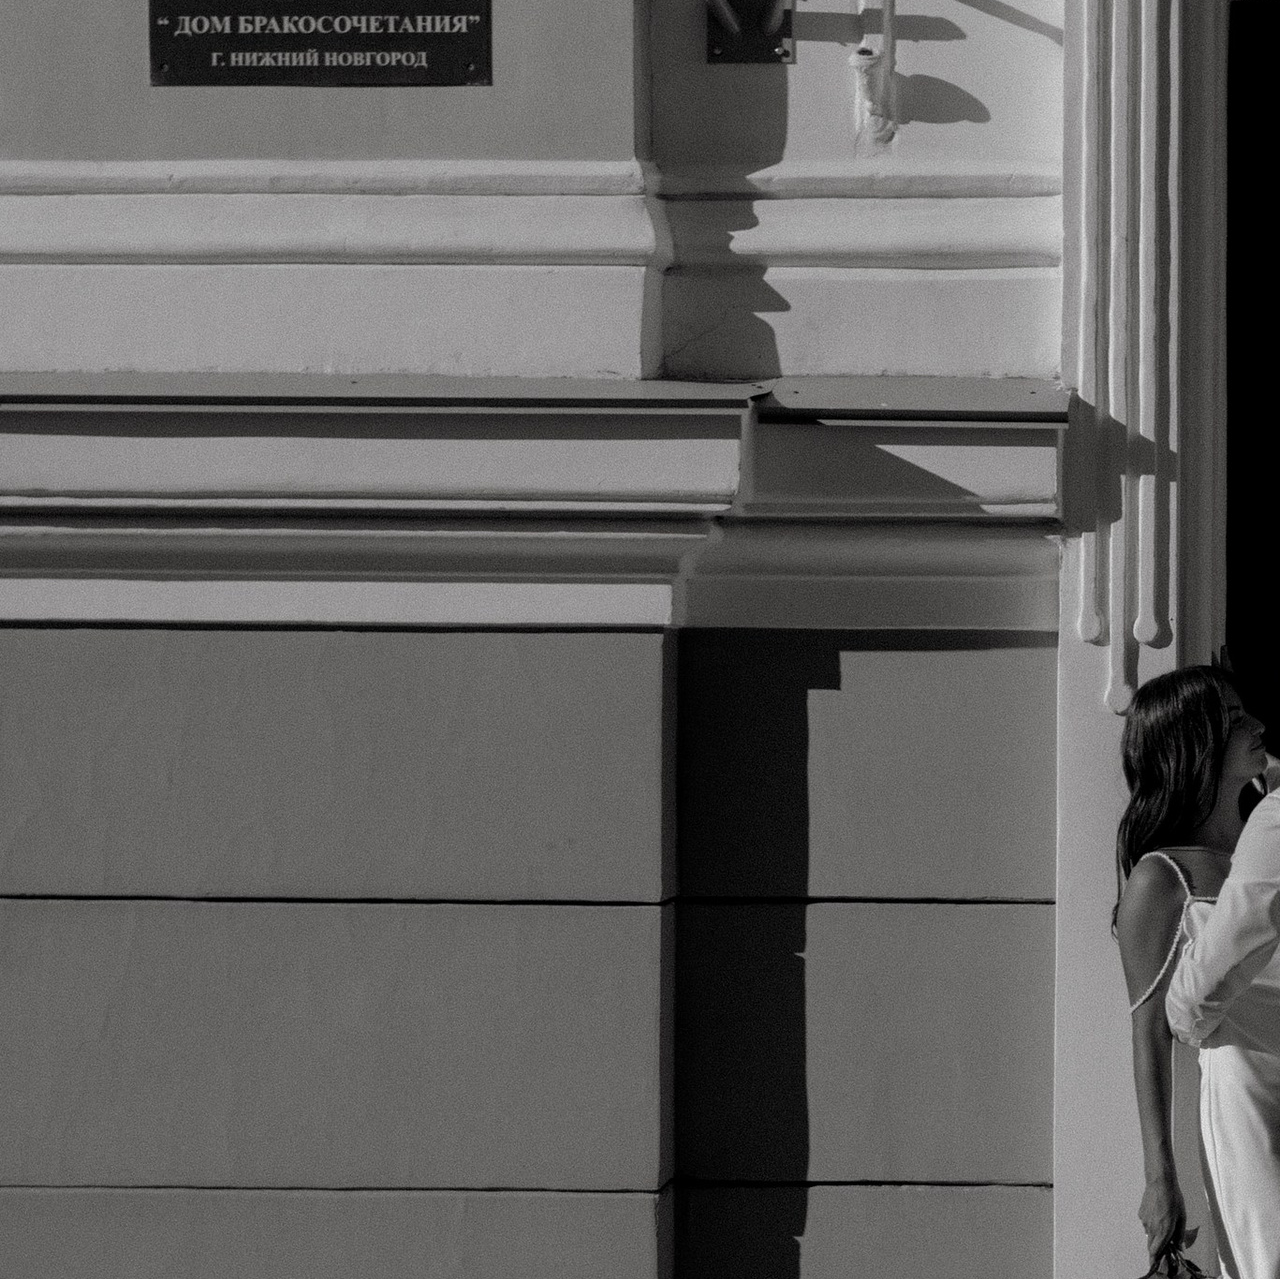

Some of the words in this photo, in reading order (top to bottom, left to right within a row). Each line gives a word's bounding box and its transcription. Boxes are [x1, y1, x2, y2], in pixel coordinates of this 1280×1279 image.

[211, 52, 226, 66] Г.
[230, 49, 318, 66] НИЖНИЙ
[325, 51, 428, 69] НОВГОРОД
